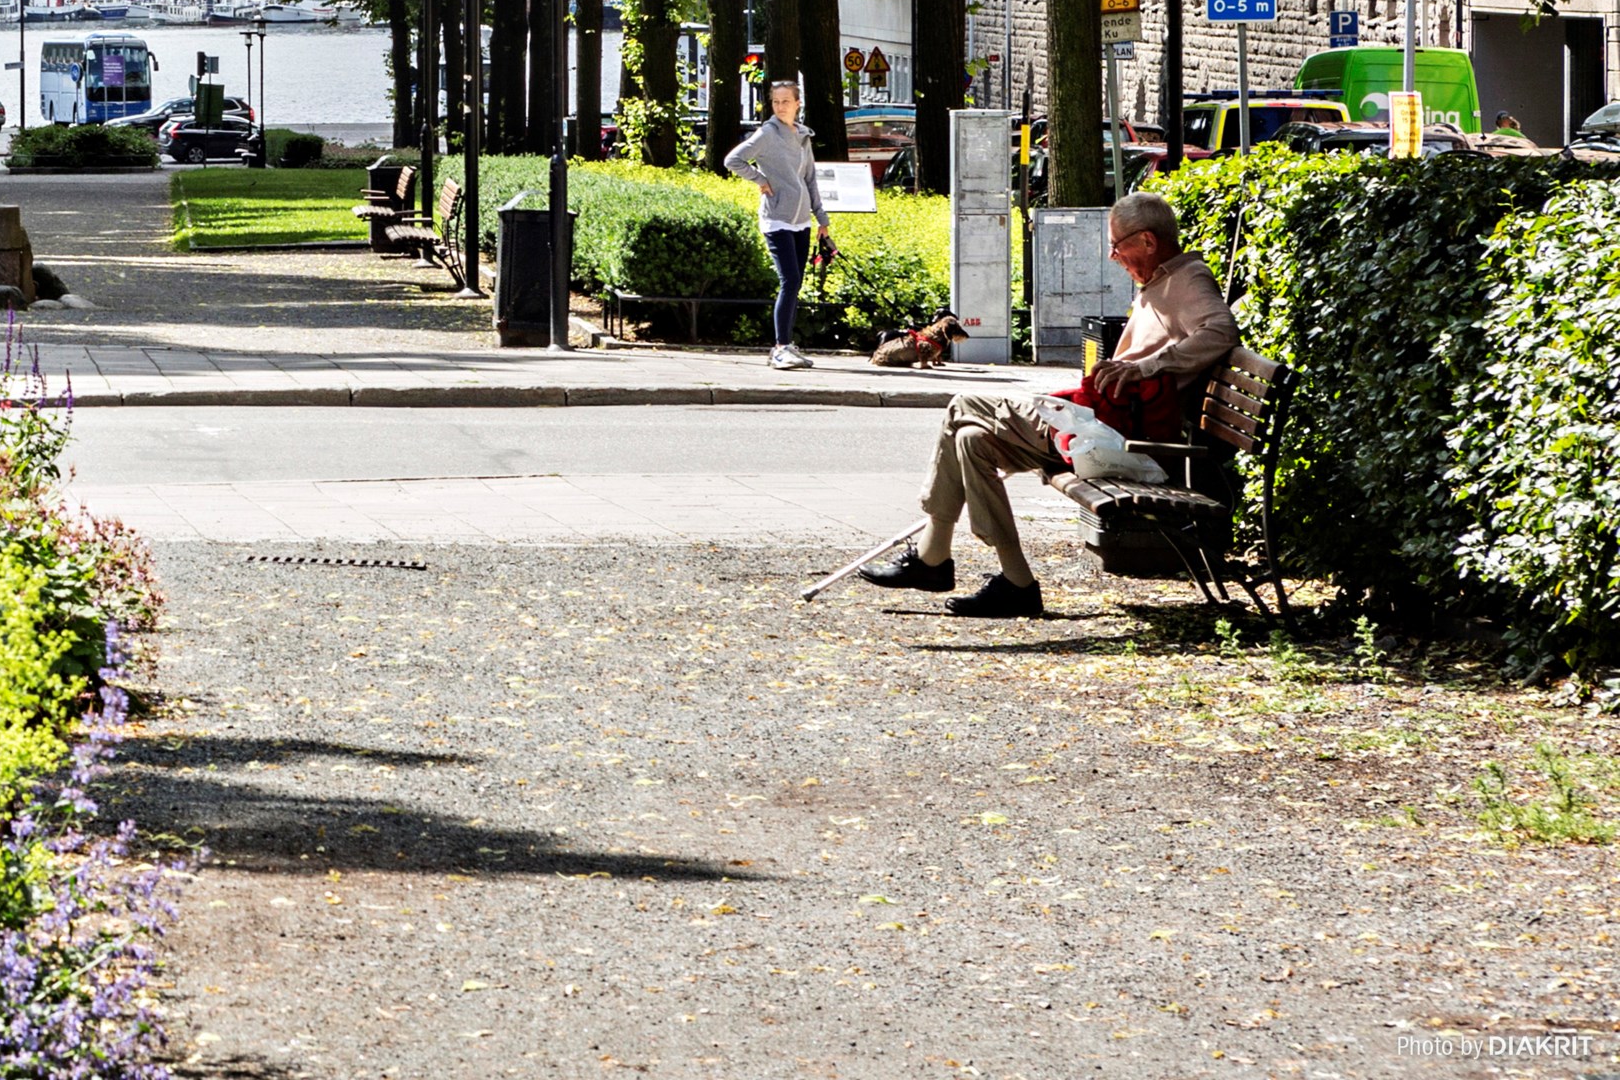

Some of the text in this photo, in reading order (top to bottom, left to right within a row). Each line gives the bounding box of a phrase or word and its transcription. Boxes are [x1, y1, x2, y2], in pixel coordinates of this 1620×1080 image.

[1214, 0, 1269, 12] 0-5 m
[1103, 17, 1132, 27] ende
[1339, 14, 1352, 33] P
[848, 56, 862, 67] 50
[963, 318, 981, 326] ABB
